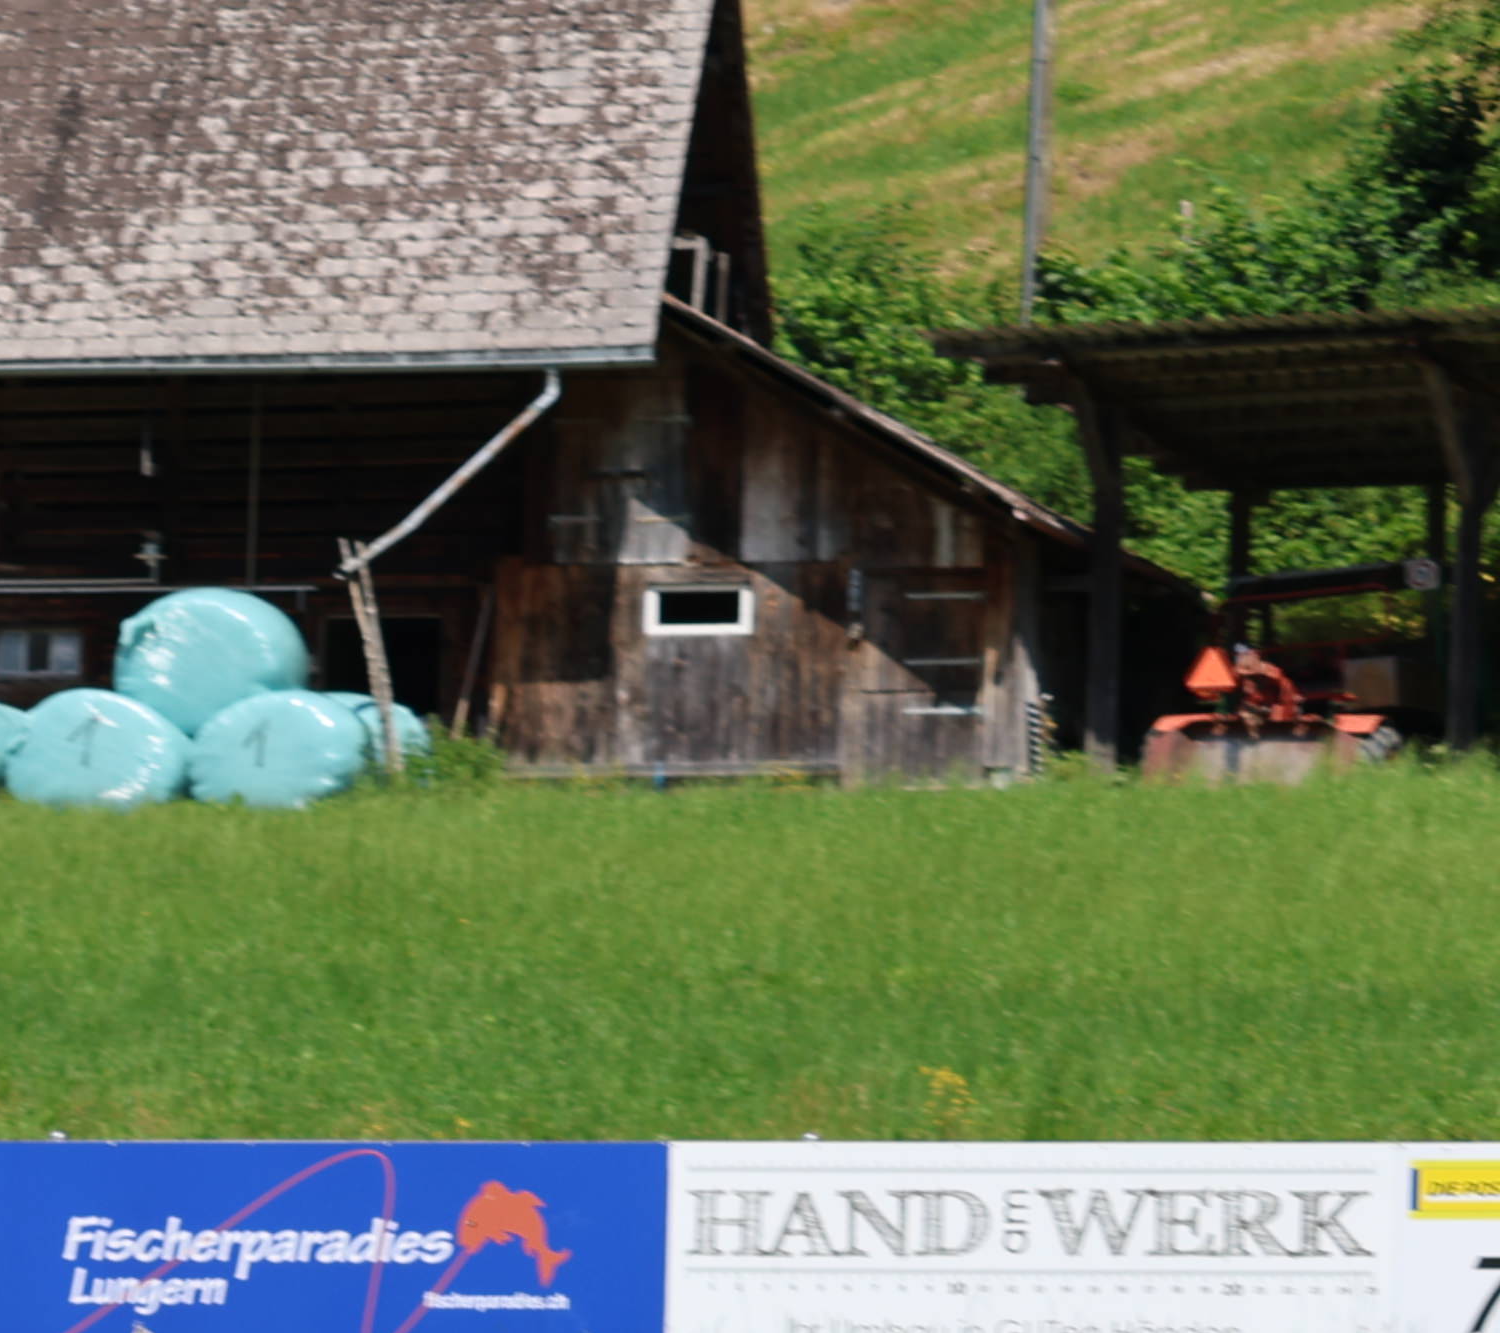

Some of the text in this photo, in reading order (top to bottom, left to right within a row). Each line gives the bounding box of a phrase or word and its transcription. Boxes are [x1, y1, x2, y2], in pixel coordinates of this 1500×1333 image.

[62, 1216, 454, 1281] Fischerparadies
[684, 1188, 993, 1258] HAND
[1034, 1187, 1378, 1259] WERK
[68, 1267, 228, 1315] Lungern
